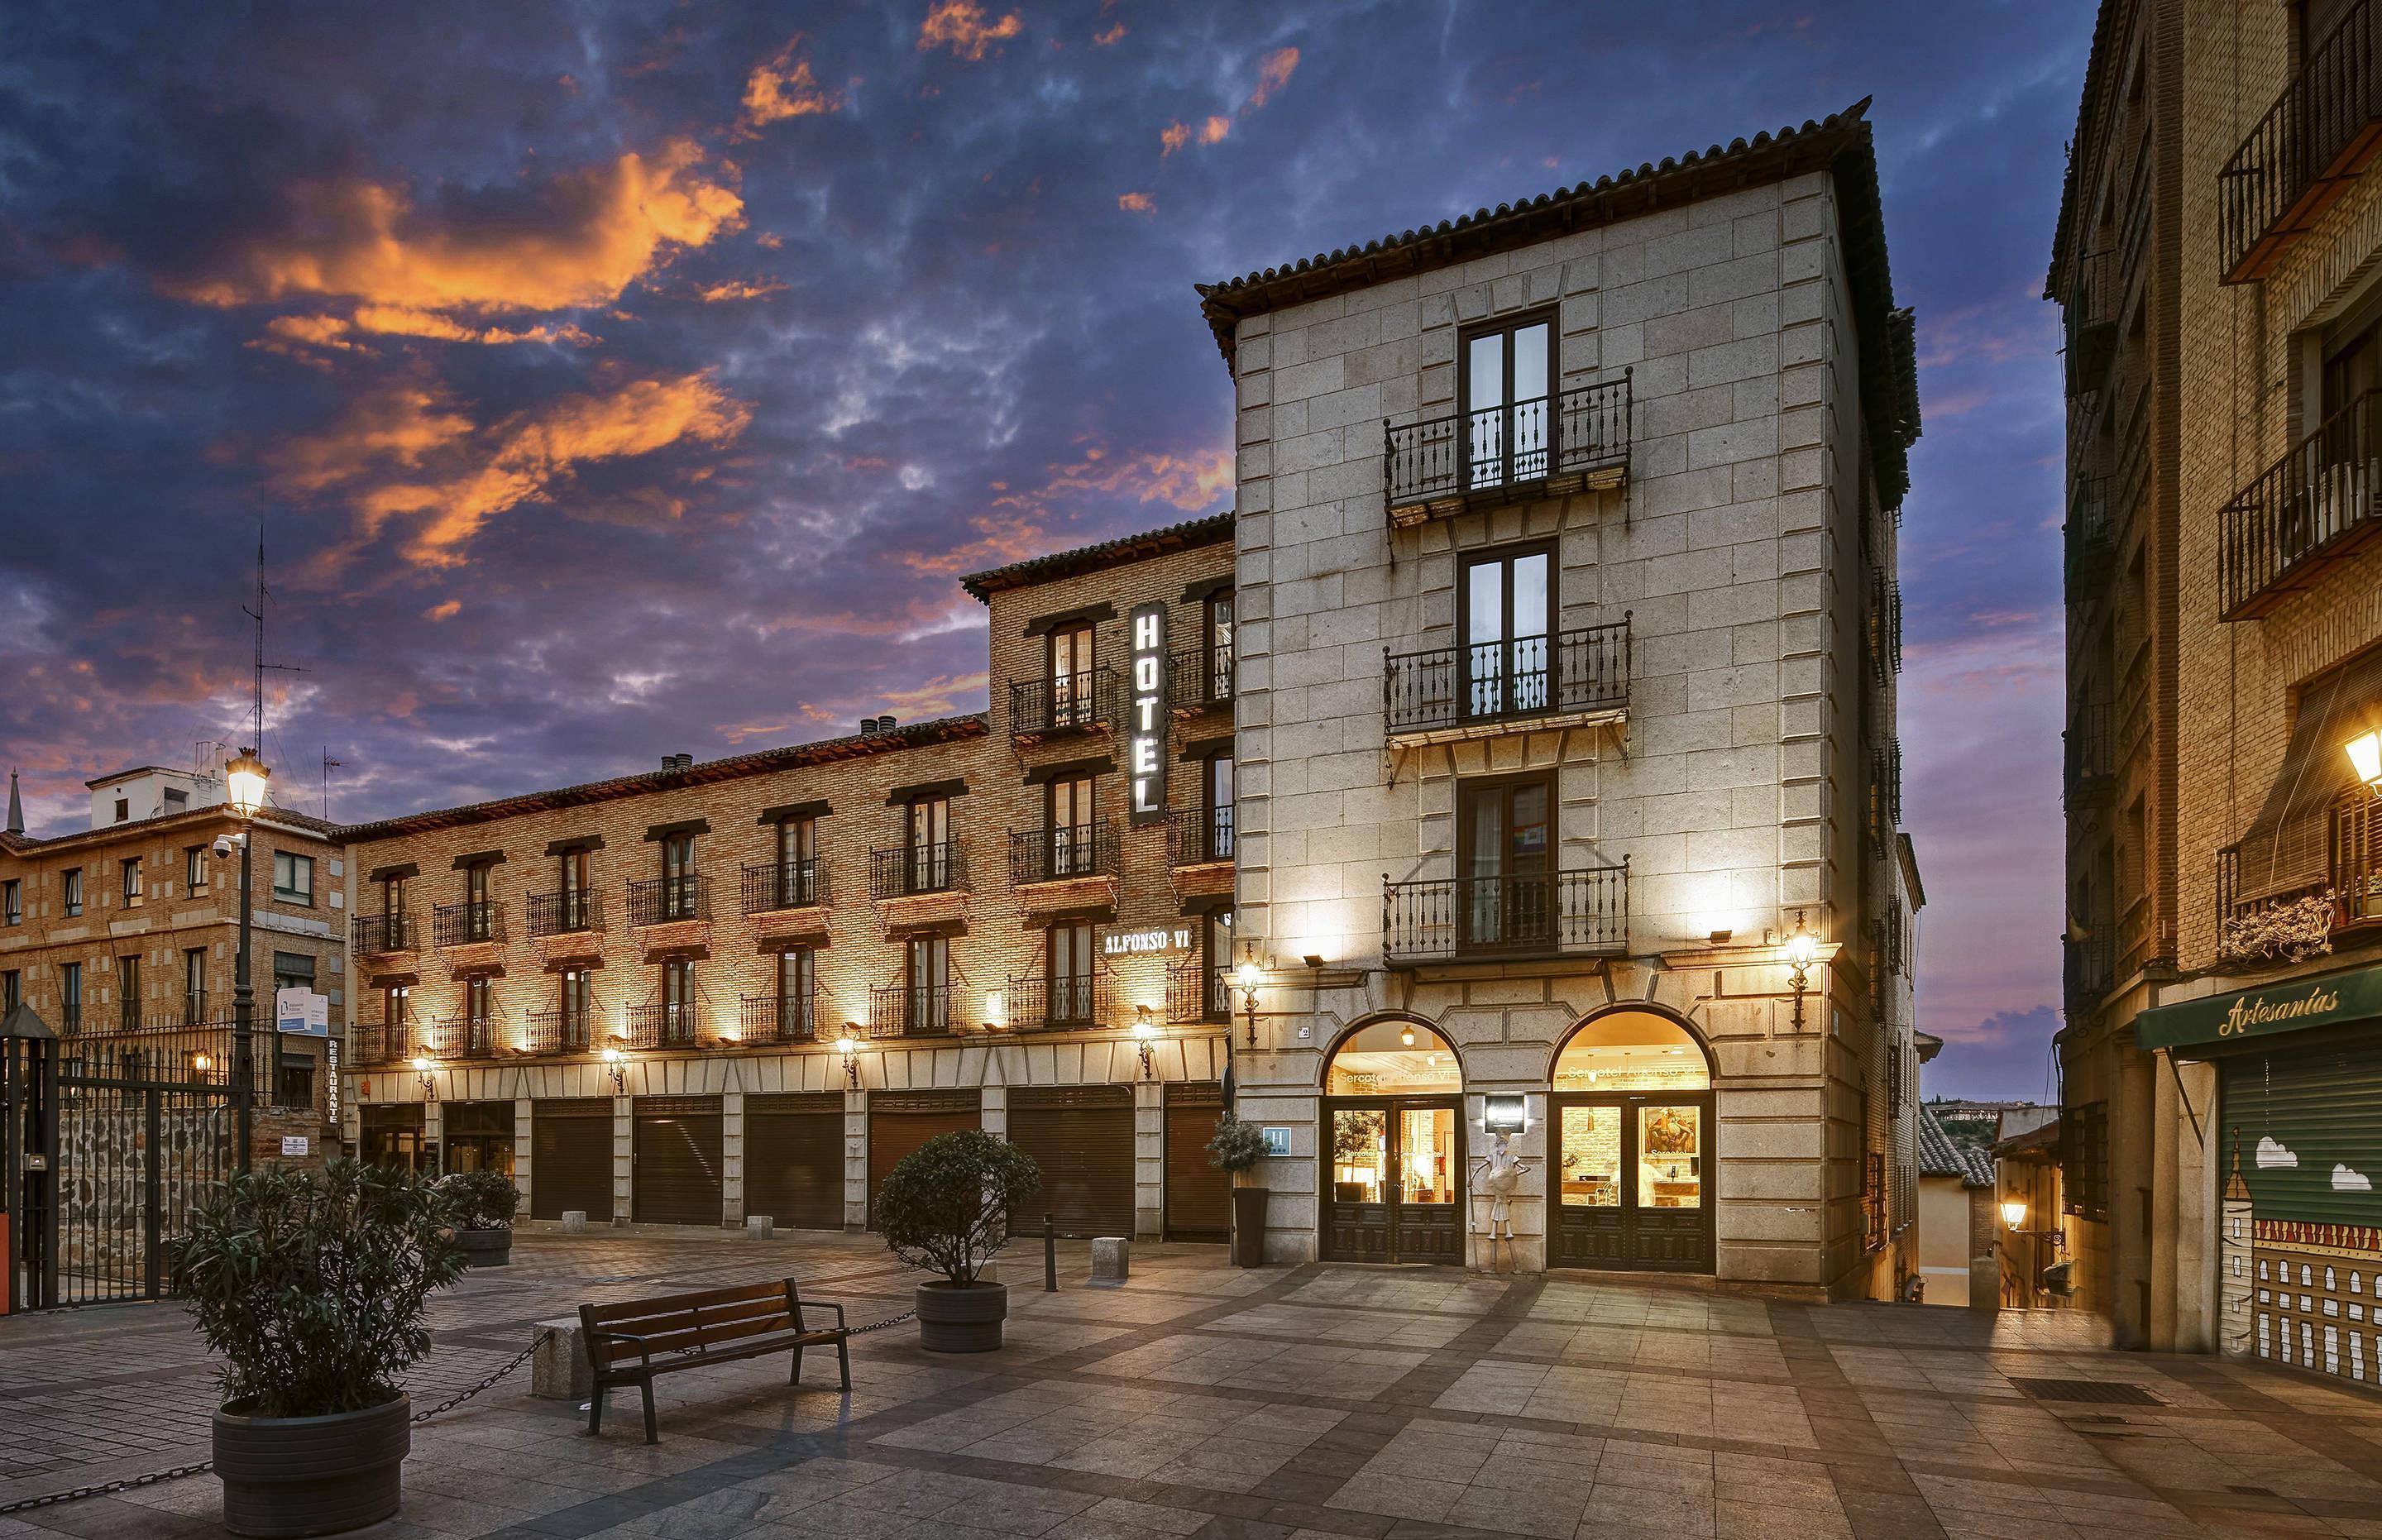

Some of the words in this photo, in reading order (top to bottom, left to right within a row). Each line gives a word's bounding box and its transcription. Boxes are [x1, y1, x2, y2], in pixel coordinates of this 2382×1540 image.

[1136, 615, 1159, 813] HOTEL
[2218, 987, 2339, 1036] Artesanías
[329, 1040, 337, 1123] RESTAURANTE
[1271, 1131, 1283, 1145] H
